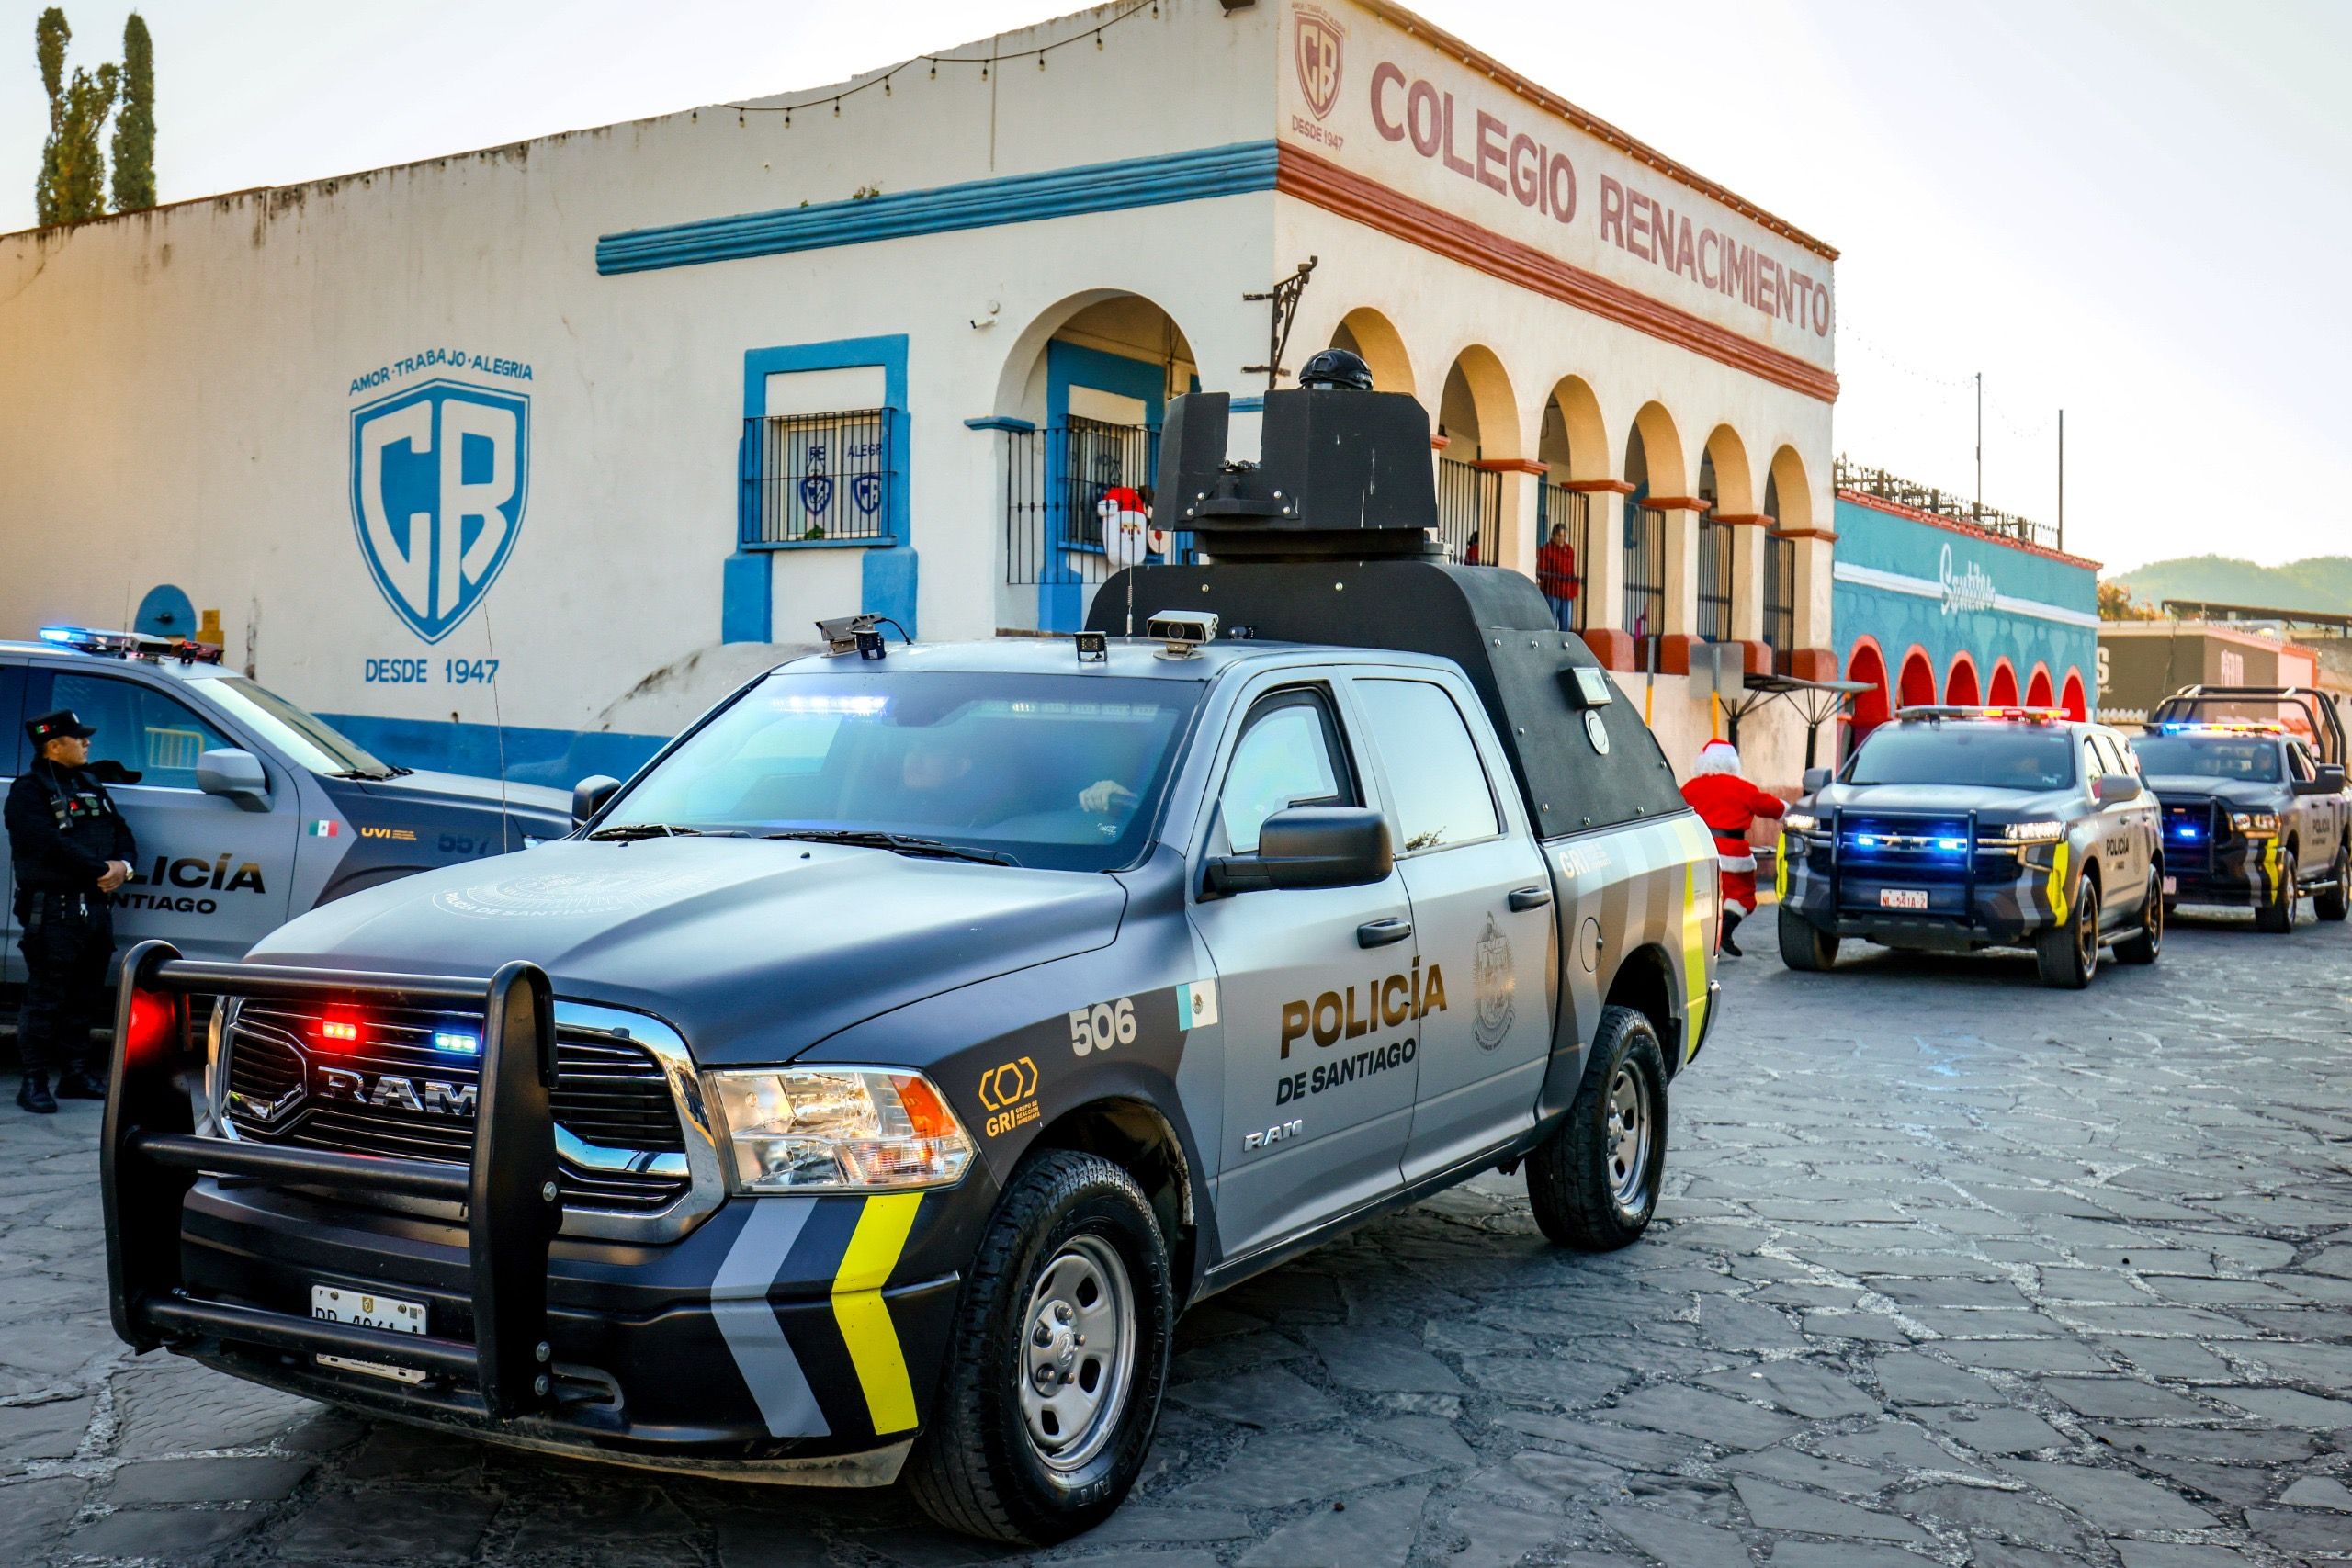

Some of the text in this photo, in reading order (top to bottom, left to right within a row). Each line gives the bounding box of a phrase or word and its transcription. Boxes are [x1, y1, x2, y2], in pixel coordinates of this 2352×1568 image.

[1292, 114, 1344, 152] DESDE 1947
[1369, 61, 1831, 338] COLEGIO RENACIMIENTO
[348, 347, 534, 396] AMOR TRABAJO ALEGRIA
[365, 658, 500, 684] DESDE 1947
[361, 827, 391, 839] UVI
[124, 852, 266, 895] ICÍA
[109, 892, 218, 915] NTIAGO
[1069, 997, 1136, 1057] 506
[1280, 954, 1448, 1061] POLICÍA
[317, 1066, 478, 1118] RAM
[1275, 1037, 1417, 1106] DE SANTIAGO
[986, 1109, 1016, 1138] GRI
[1243, 1118, 1304, 1154] RAM
